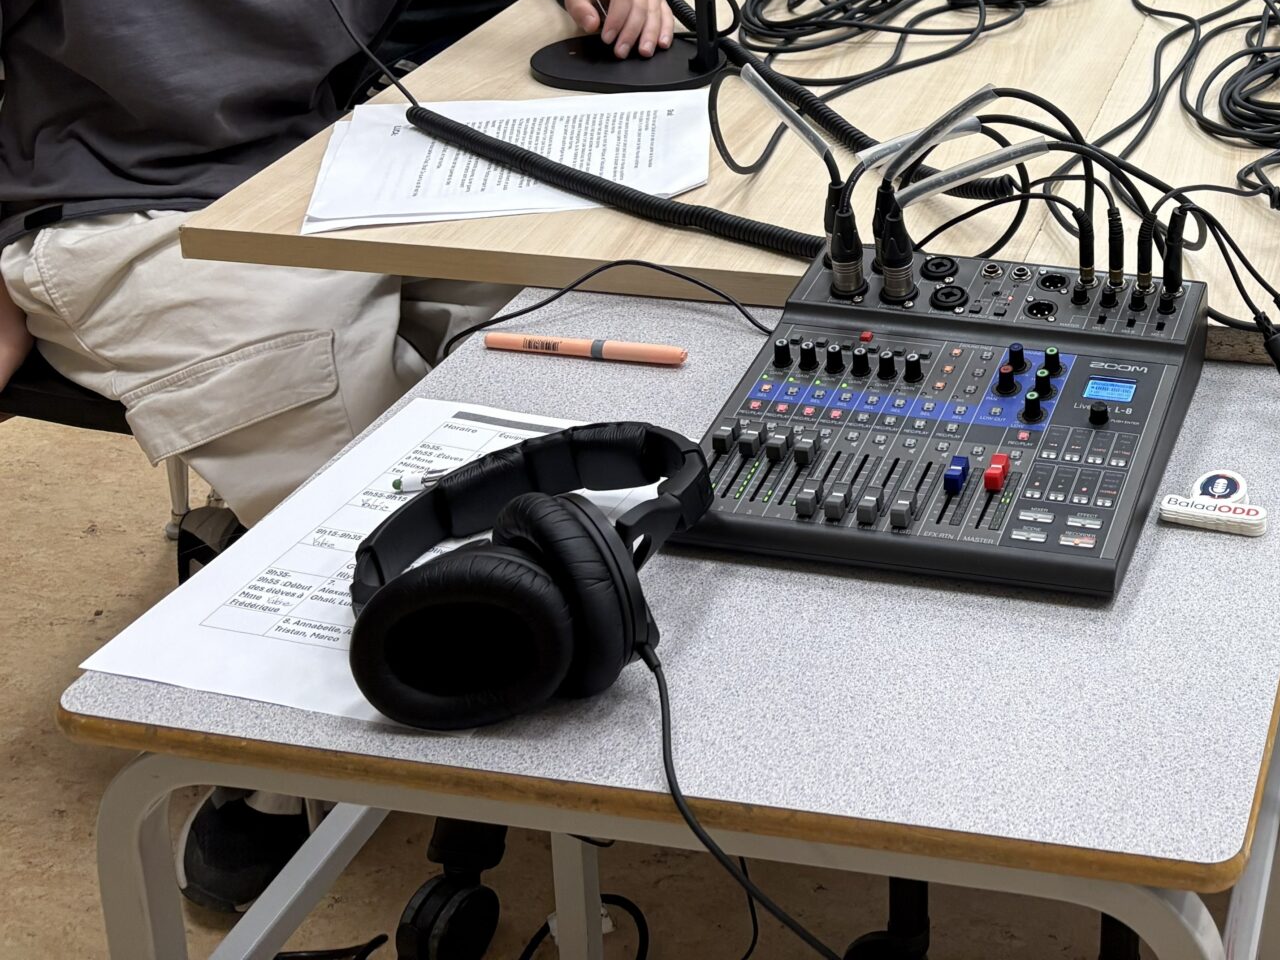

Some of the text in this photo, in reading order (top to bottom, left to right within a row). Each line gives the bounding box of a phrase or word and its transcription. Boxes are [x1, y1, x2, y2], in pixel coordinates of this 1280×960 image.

[1089, 361, 1148, 373] ZOOM
[1114, 406, 1133, 415] L-8
[443, 423, 478, 434] Horaire
[362, 490, 409, 502] 8h55-9h15
[1167, 497, 1260, 517] BaladODD
[315, 528, 363, 541] 9h15-9h35
[963, 535, 995, 544] MASTER
[266, 569, 292, 578] 9h35-
[257, 576, 281, 585] 9h55
[238, 591, 263, 601] Mme
[248, 584, 264, 592] des
[266, 585, 300, 599] élèves
[228, 598, 281, 613] Frédérique
[310, 594, 337, 605] Ghali,
[282, 617, 291, 625] 8.
[292, 619, 343, 634] Annabelle,
[274, 625, 340, 643] Tristan, Marco
